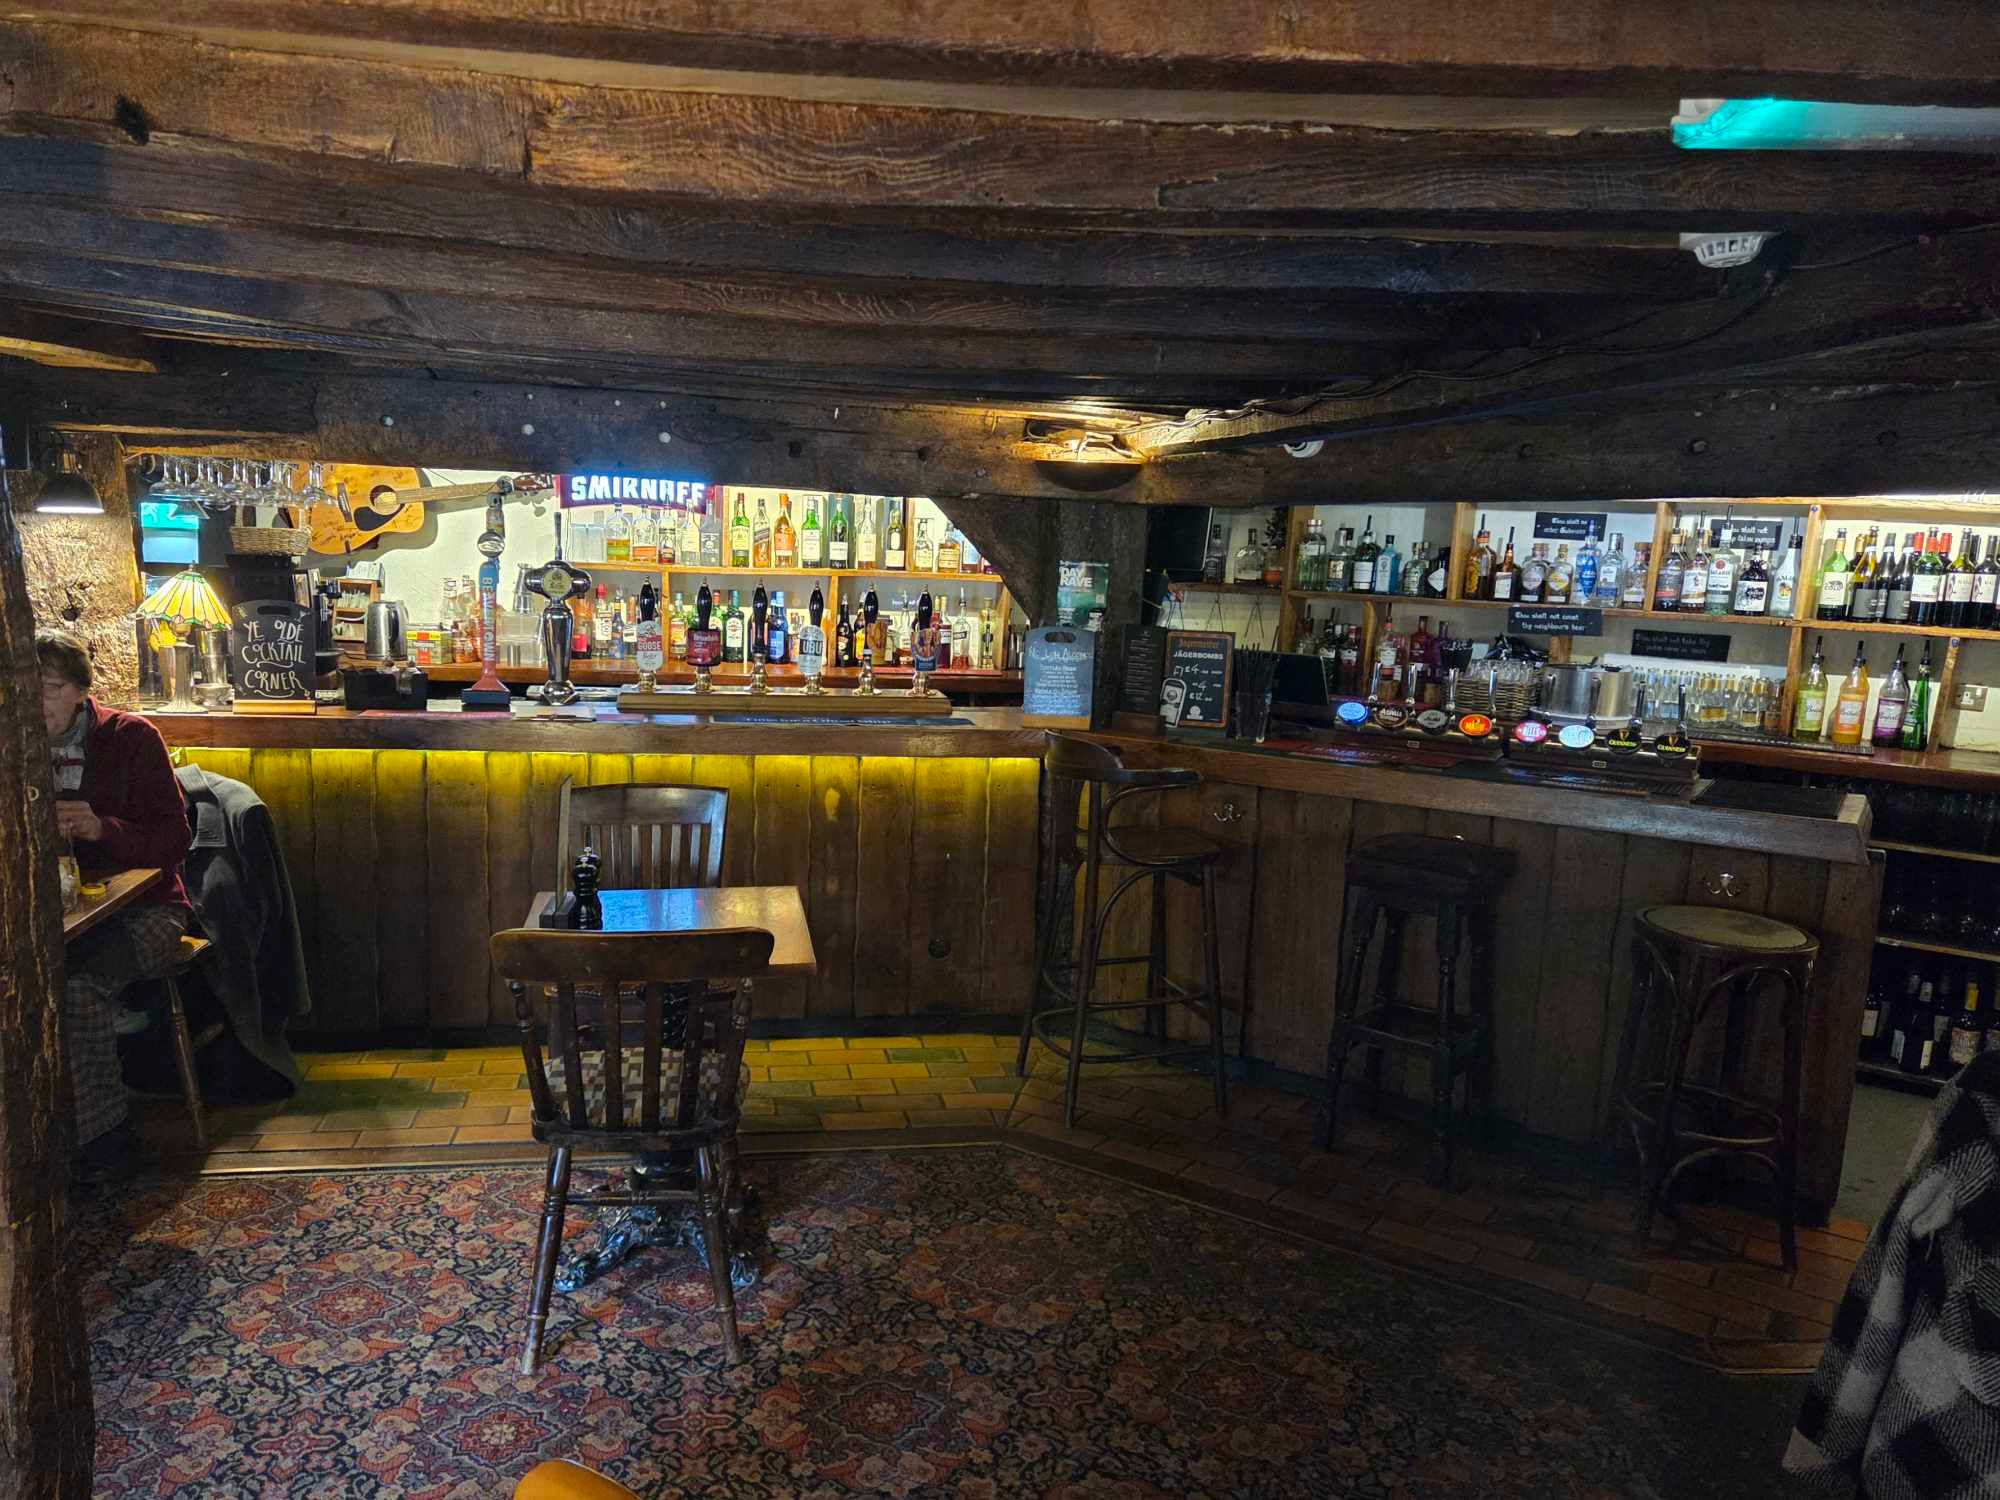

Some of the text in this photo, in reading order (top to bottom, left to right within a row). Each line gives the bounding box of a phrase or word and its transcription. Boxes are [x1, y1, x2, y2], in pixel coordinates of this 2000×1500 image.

[1059, 566, 1085, 577] DAY
[1060, 577, 1092, 587] RAVE
[243, 620, 304, 643] YE OLDE
[242, 642, 306, 664] COCKTAIL
[802, 641, 821, 653] UBU
[245, 670, 305, 692] CORNER
